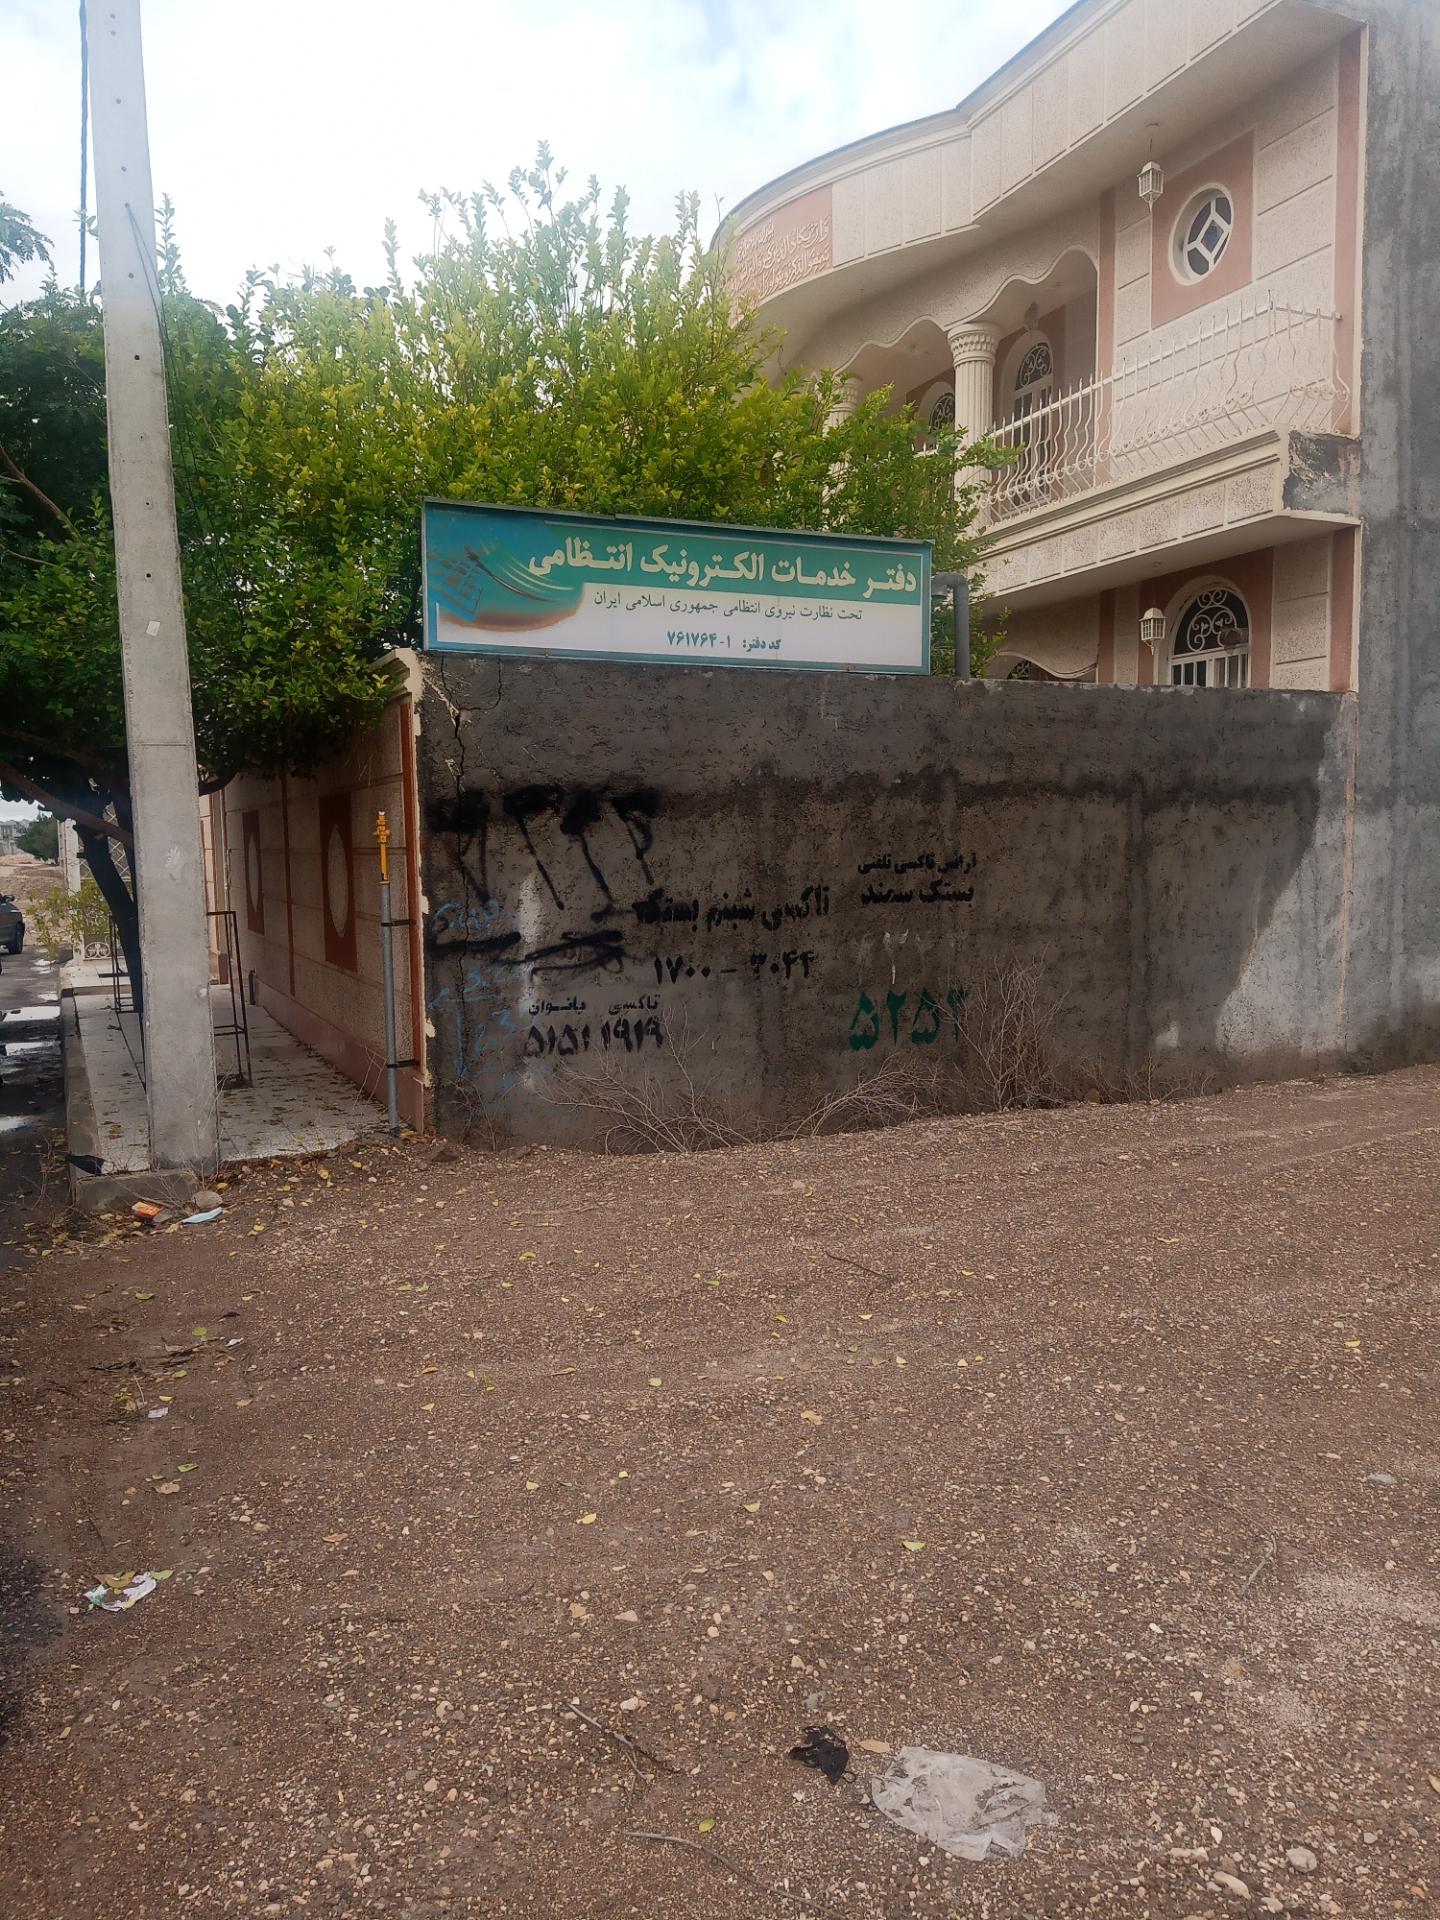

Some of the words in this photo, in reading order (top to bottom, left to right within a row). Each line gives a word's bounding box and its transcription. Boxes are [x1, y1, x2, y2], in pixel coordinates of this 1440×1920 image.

[528, 536, 633, 577] انتظامی
[639, 543, 765, 588] الکترونیک
[771, 555, 857, 587] خدمات
[861, 562, 918, 599] دفتر
[593, 590, 621, 610] ایران
[625, 594, 666, 612] اسلامی
[669, 600, 719, 615] جمهوری
[722, 600, 761, 618] انتظامی
[764, 605, 796, 621] نیروی
[800, 605, 834, 621] نظارت
[836, 608, 863, 621] تحت
[768, 637, 783, 650] کد
[918, 878, 975, 909] بستک
[653, 955, 712, 985] ۱۷۰۰
[528, 995, 587, 1016] بانوان
[607, 993, 661, 1016] تاکسی
